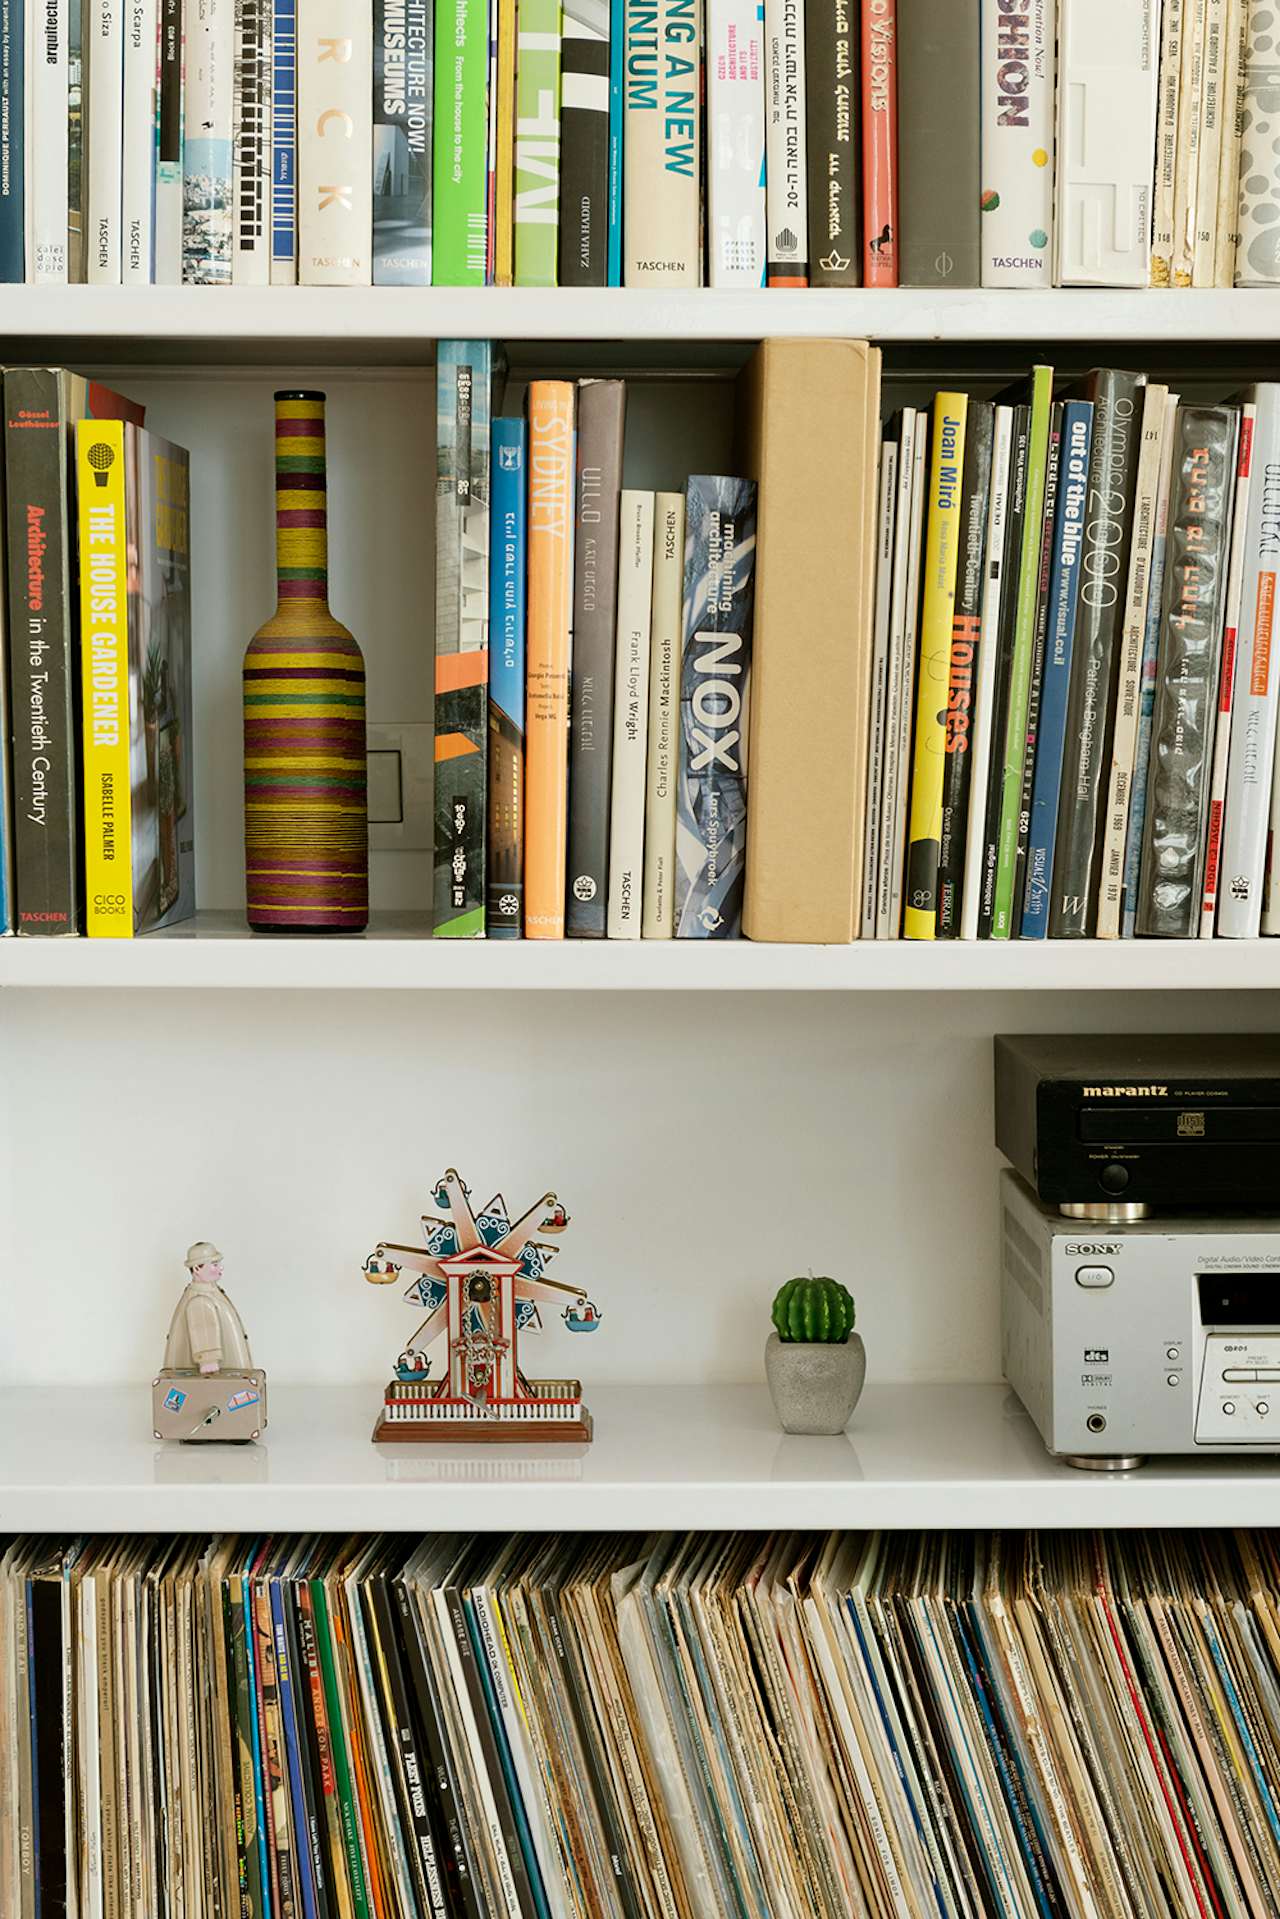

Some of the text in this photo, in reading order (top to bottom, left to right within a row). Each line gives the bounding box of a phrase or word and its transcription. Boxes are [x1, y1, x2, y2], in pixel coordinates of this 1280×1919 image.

[102, 13, 112, 37] Siza
[131, 7, 144, 48] Scarpa
[665, 54, 696, 79] A
[784, 43, 798, 121] הישראלית
[1034, 47, 1046, 80] Now!
[833, 39, 852, 142] מחוץ לחומות
[407, 104, 426, 153] NOW!
[452, 56, 465, 184] From the house to the city
[665, 91, 696, 178] NEW
[2, 142, 10, 196] DOMINIQUE
[785, 126, 798, 169] במאה
[828, 152, 840, 176] דוד
[99, 218, 109, 268] TASCHEN
[130, 219, 140, 270] TASCHEN
[580, 196, 590, 268] ZAHA HADID
[312, 257, 361, 268] TASCHEN
[381, 257, 429, 268] TASCHEN
[637, 261, 686, 272] TASCHEN
[992, 257, 1043, 269] TASCHEN
[938, 416, 961, 510] Joan Miró
[1018, 448, 1026, 465] Viva
[1091, 395, 1107, 485] Architecture
[1108, 398, 1134, 487] Olympic
[531, 415, 568, 540] SYDNEY
[581, 467, 601, 524] חדרים
[1014, 465, 1025, 514] Arquitectura
[665, 510, 676, 560] TASCHEN
[1053, 421, 1087, 666] out of the blue www.visual.co.il
[1137, 495, 1151, 550] L'ARCHITECTURE
[504, 543, 516, 576] משרד
[707, 511, 721, 614] architecture
[718, 523, 736, 613] machining
[960, 494, 984, 611] Twentieth-Century
[1081, 488, 1126, 608] 2000
[504, 580, 517, 610] החוץ
[89, 504, 119, 748] THE HOUSE GARDENER
[503, 614, 516, 668] בירושלים
[1126, 624, 1139, 673] ARCHITECTURE
[27, 504, 53, 827] Architecture in the Twentieth Century
[625, 631, 642, 741] Frank Lloyd Wright
[945, 614, 981, 754] Houses
[1085, 658, 1101, 706] Patrick
[657, 638, 672, 798] Charles Rennie Mackintosh
[691, 631, 743, 772] NOX
[101, 773, 115, 862] ISABELLE PALMER
[707, 791, 721, 887] Lars Spuybroek
[1018, 811, 1029, 834] 029
[984, 843, 996, 916] La biblioteca digital
[1108, 849, 1121, 877] JANVIER
[20, 912, 68, 923] TASCHEN
[93, 894, 126, 906] CICO
[94, 906, 126, 915] BOOKS
[621, 871, 632, 920] TASCHEN
[879, 891, 887, 915] Grandes
[1083, 1085, 1169, 1097] marantz
[1065, 1243, 1124, 1256] SONY
[1086, 1351, 1108, 1362] dts
[475, 1595, 496, 1658] RADIOHEAD
[493, 1670, 509, 1709] COMPUTER
